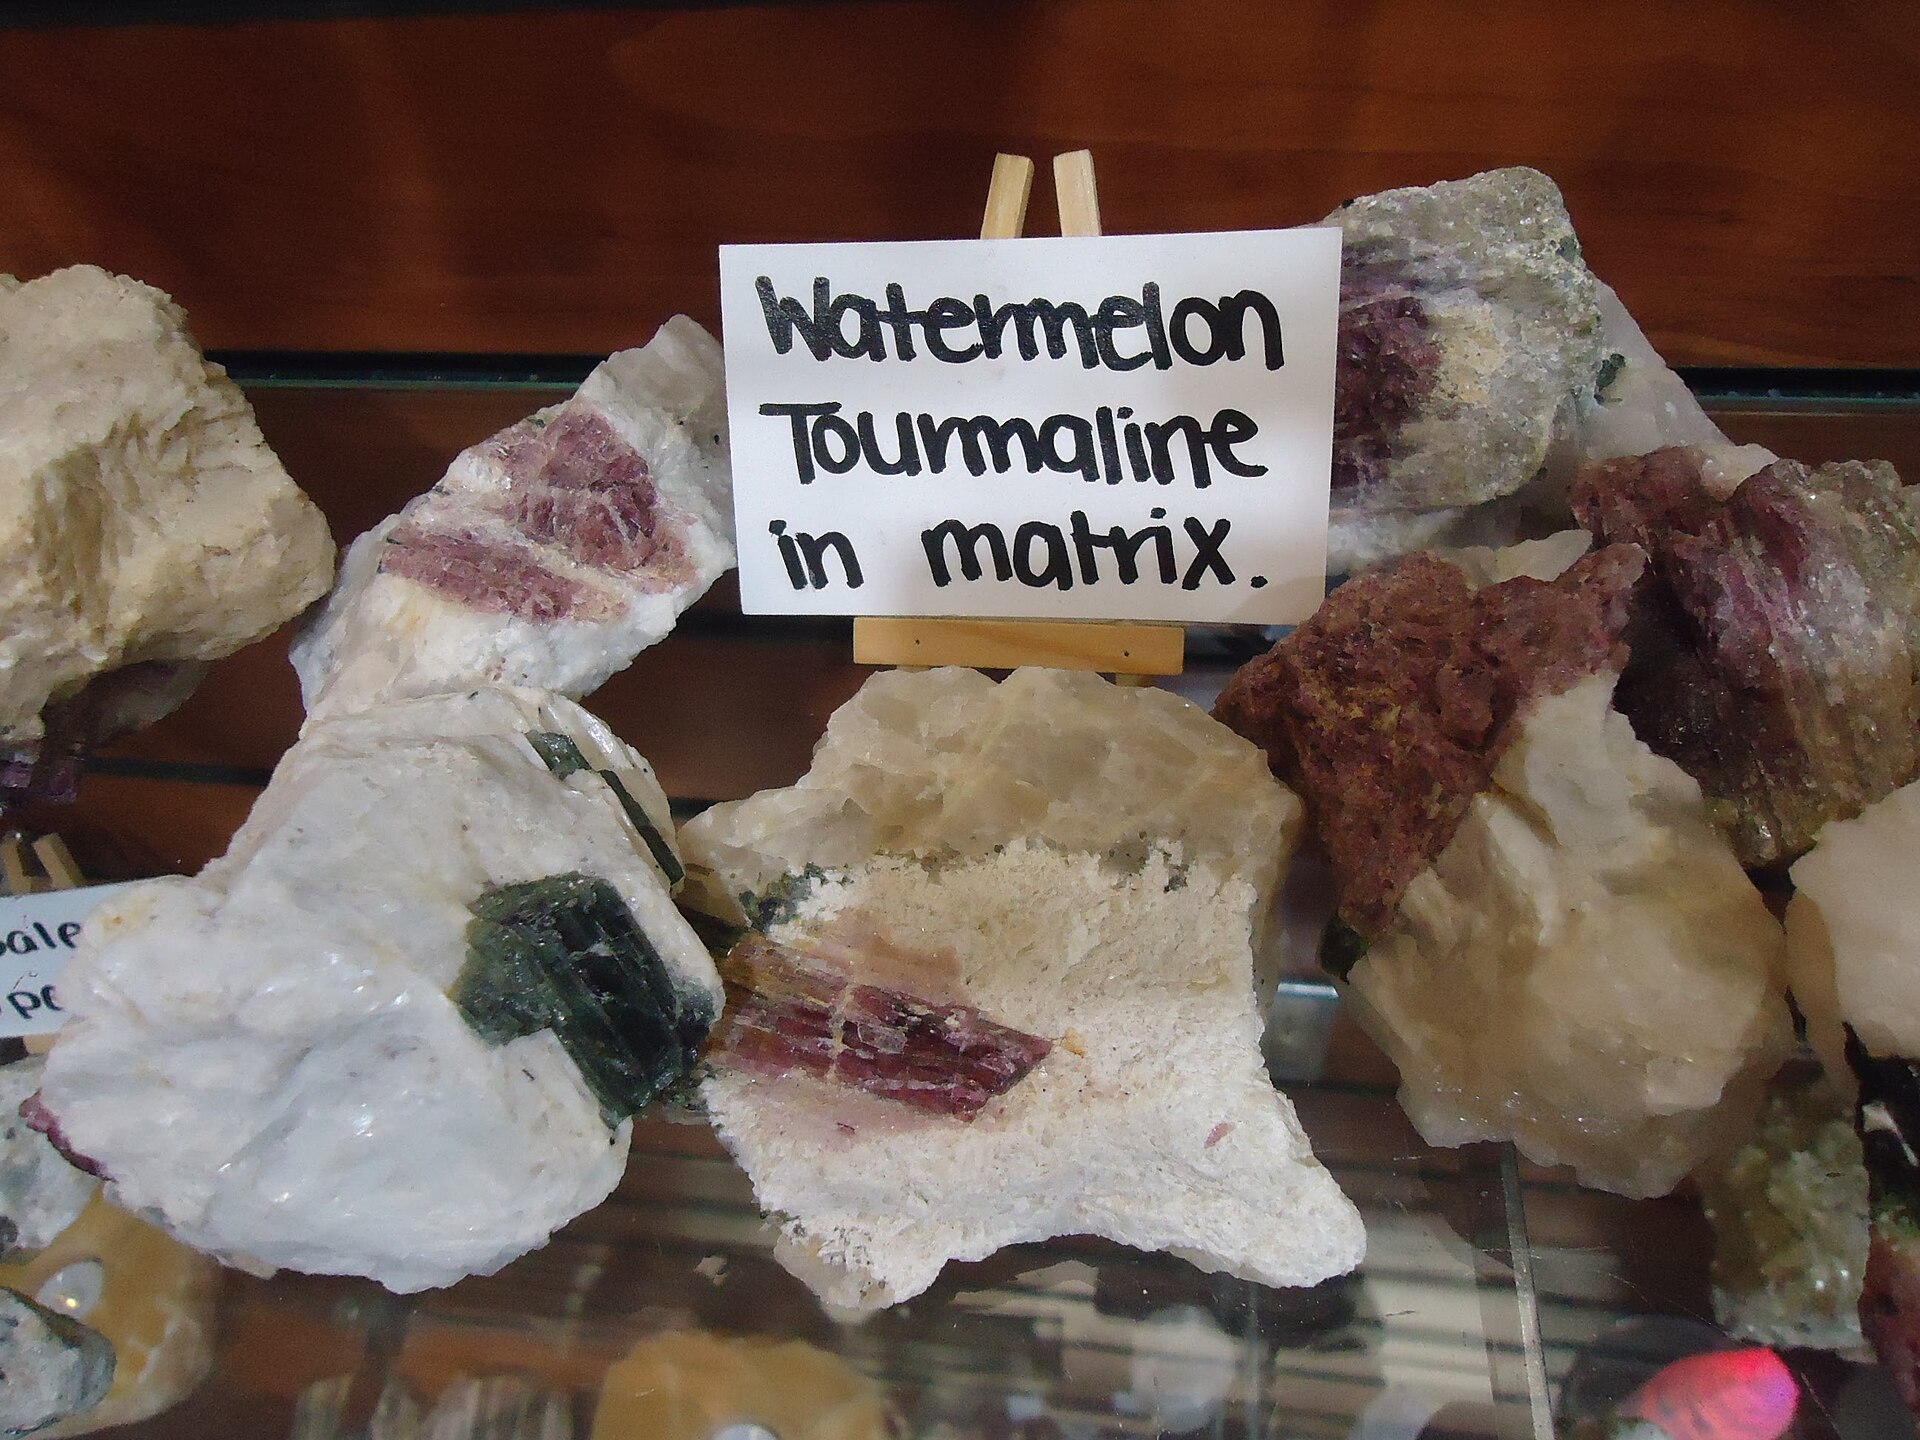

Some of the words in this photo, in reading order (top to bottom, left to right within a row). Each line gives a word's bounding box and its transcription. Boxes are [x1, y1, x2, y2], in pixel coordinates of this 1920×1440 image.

[755, 275, 1285, 372] Watermelon
[758, 401, 1270, 489] Tourmaline
[768, 519, 864, 590] in
[920, 507, 1269, 592] matrix.
